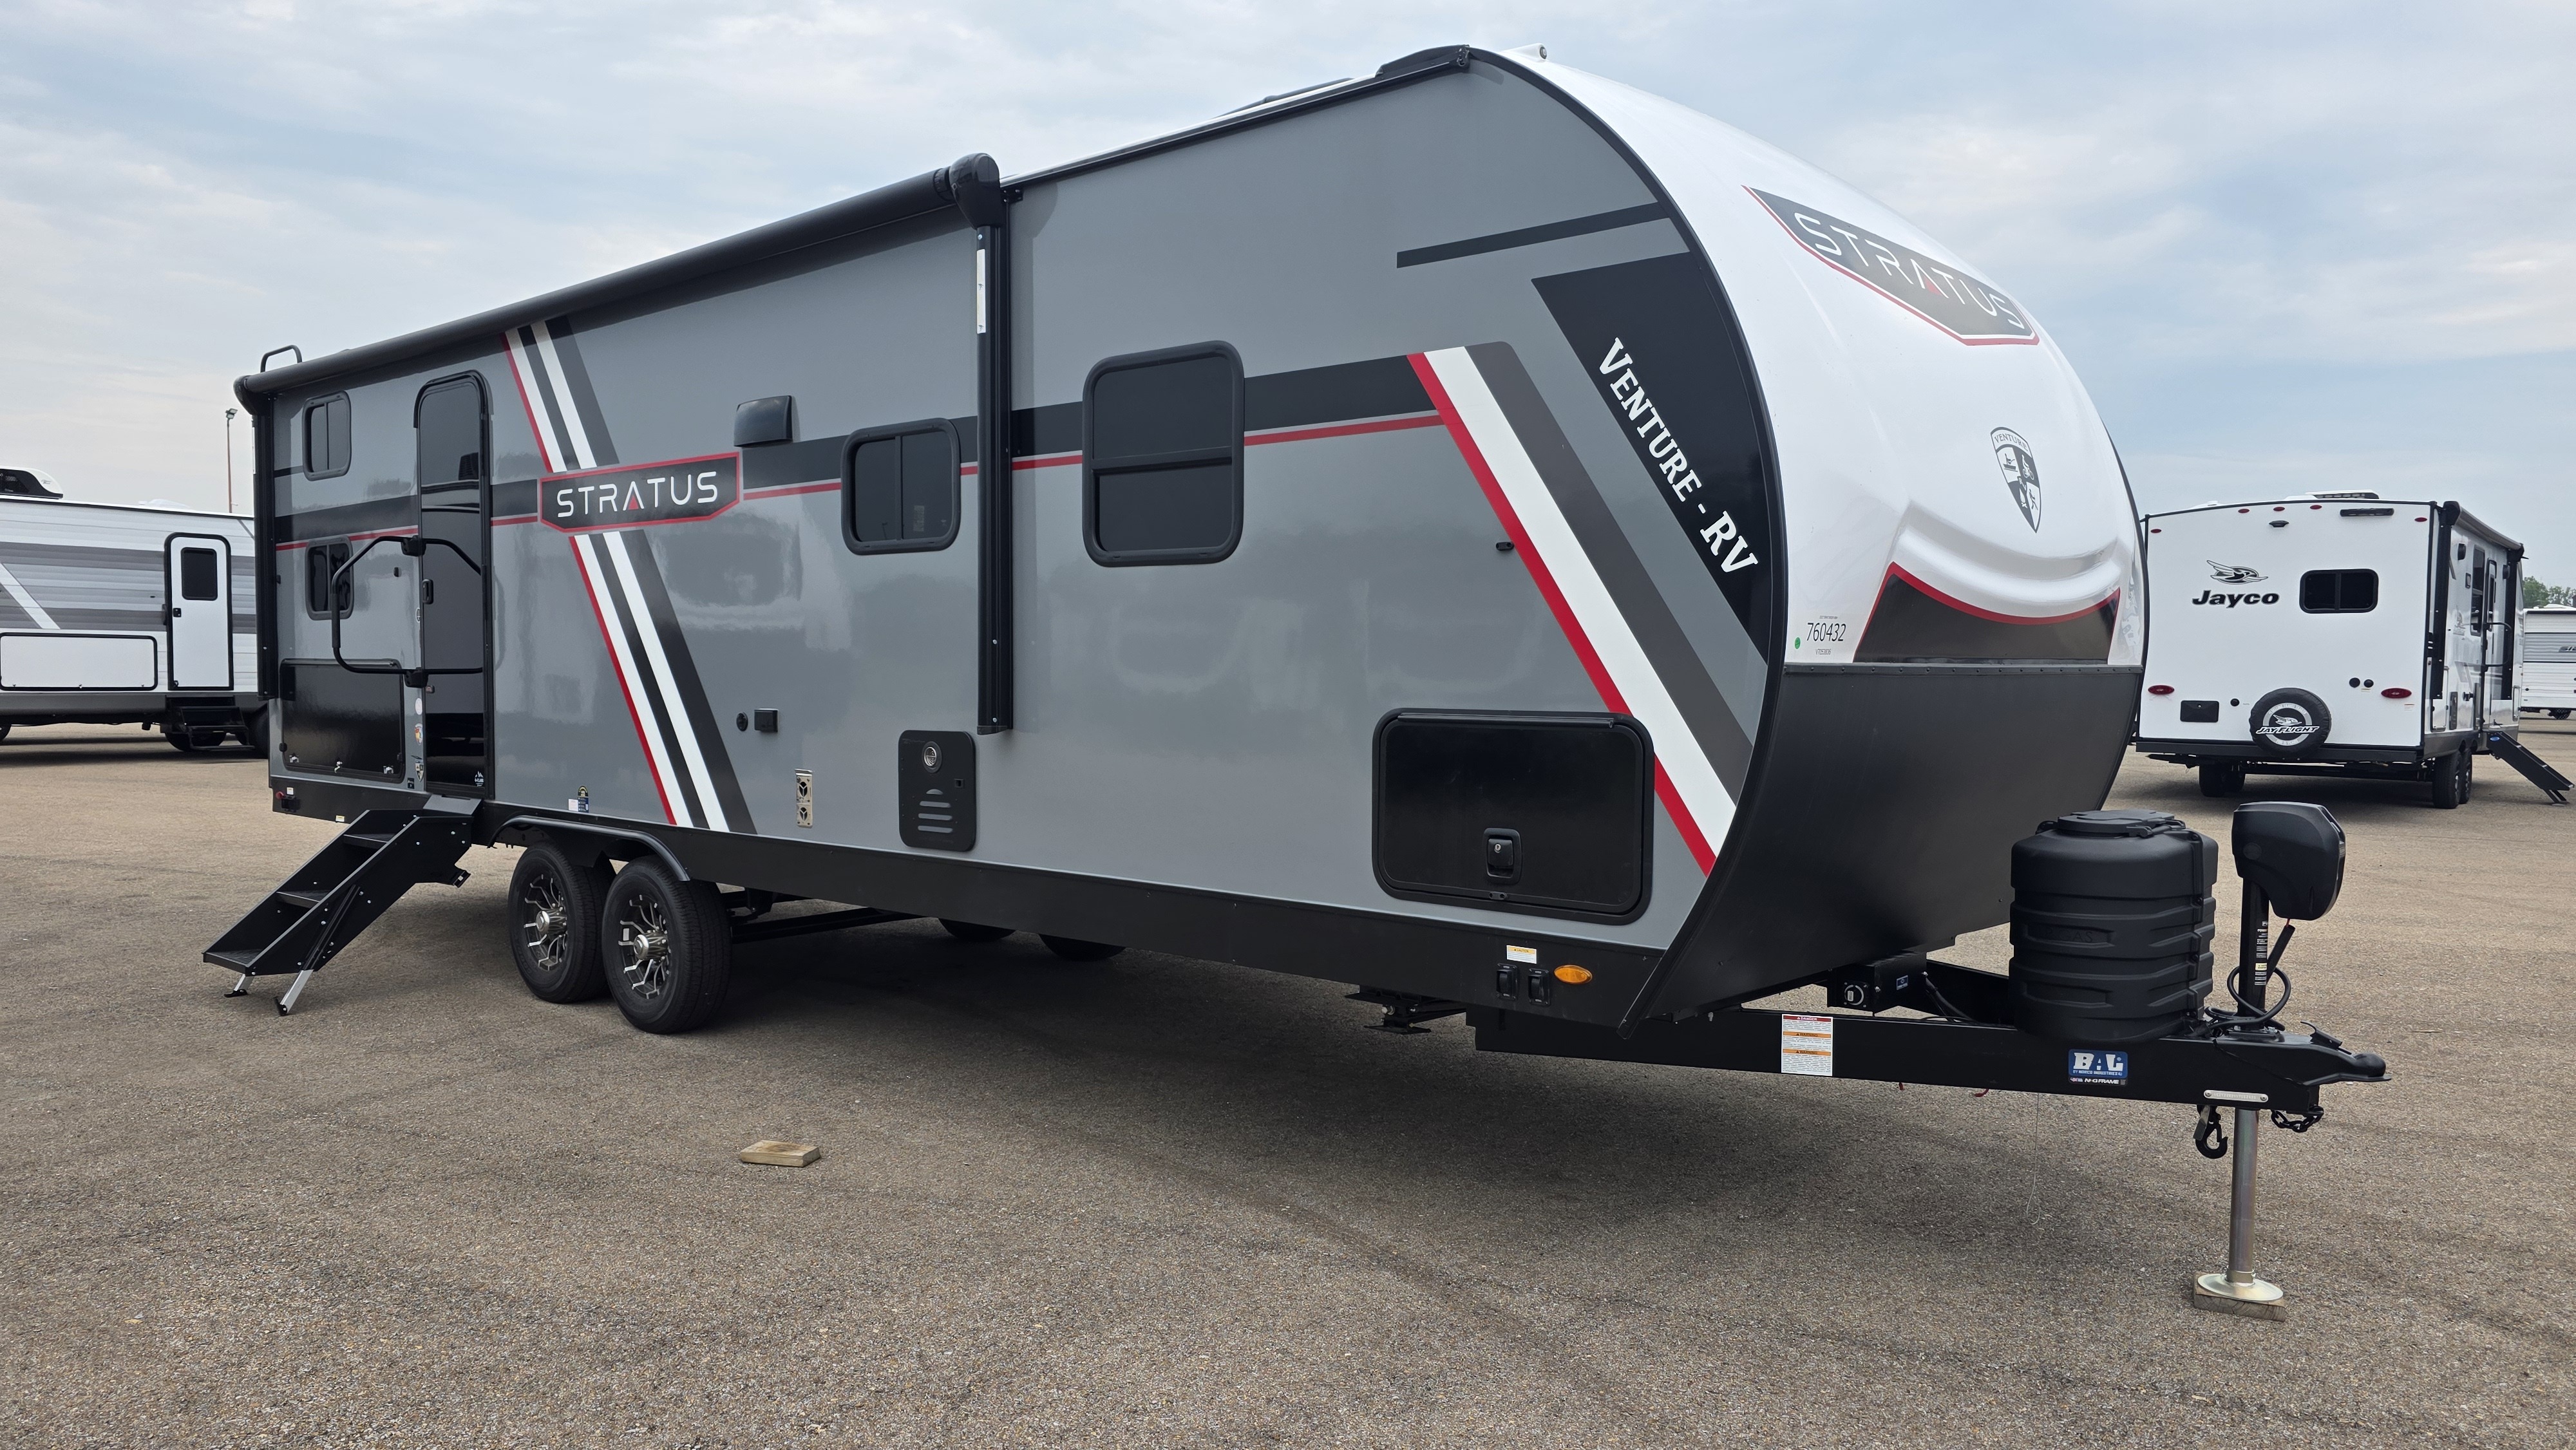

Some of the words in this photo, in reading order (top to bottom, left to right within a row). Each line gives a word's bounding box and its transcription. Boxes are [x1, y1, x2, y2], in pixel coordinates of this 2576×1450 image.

[1794, 212, 2025, 329] STRATUS
[1994, 433, 2029, 451] VENTURE
[1599, 337, 1702, 502] VENTURE
[1700, 511, 1758, 572] RV
[557, 471, 718, 518] STRATUS
[2192, 590, 2280, 608] Jayco
[1806, 623, 1846, 642] 760432
[2073, 1052, 2124, 1071] BAL
